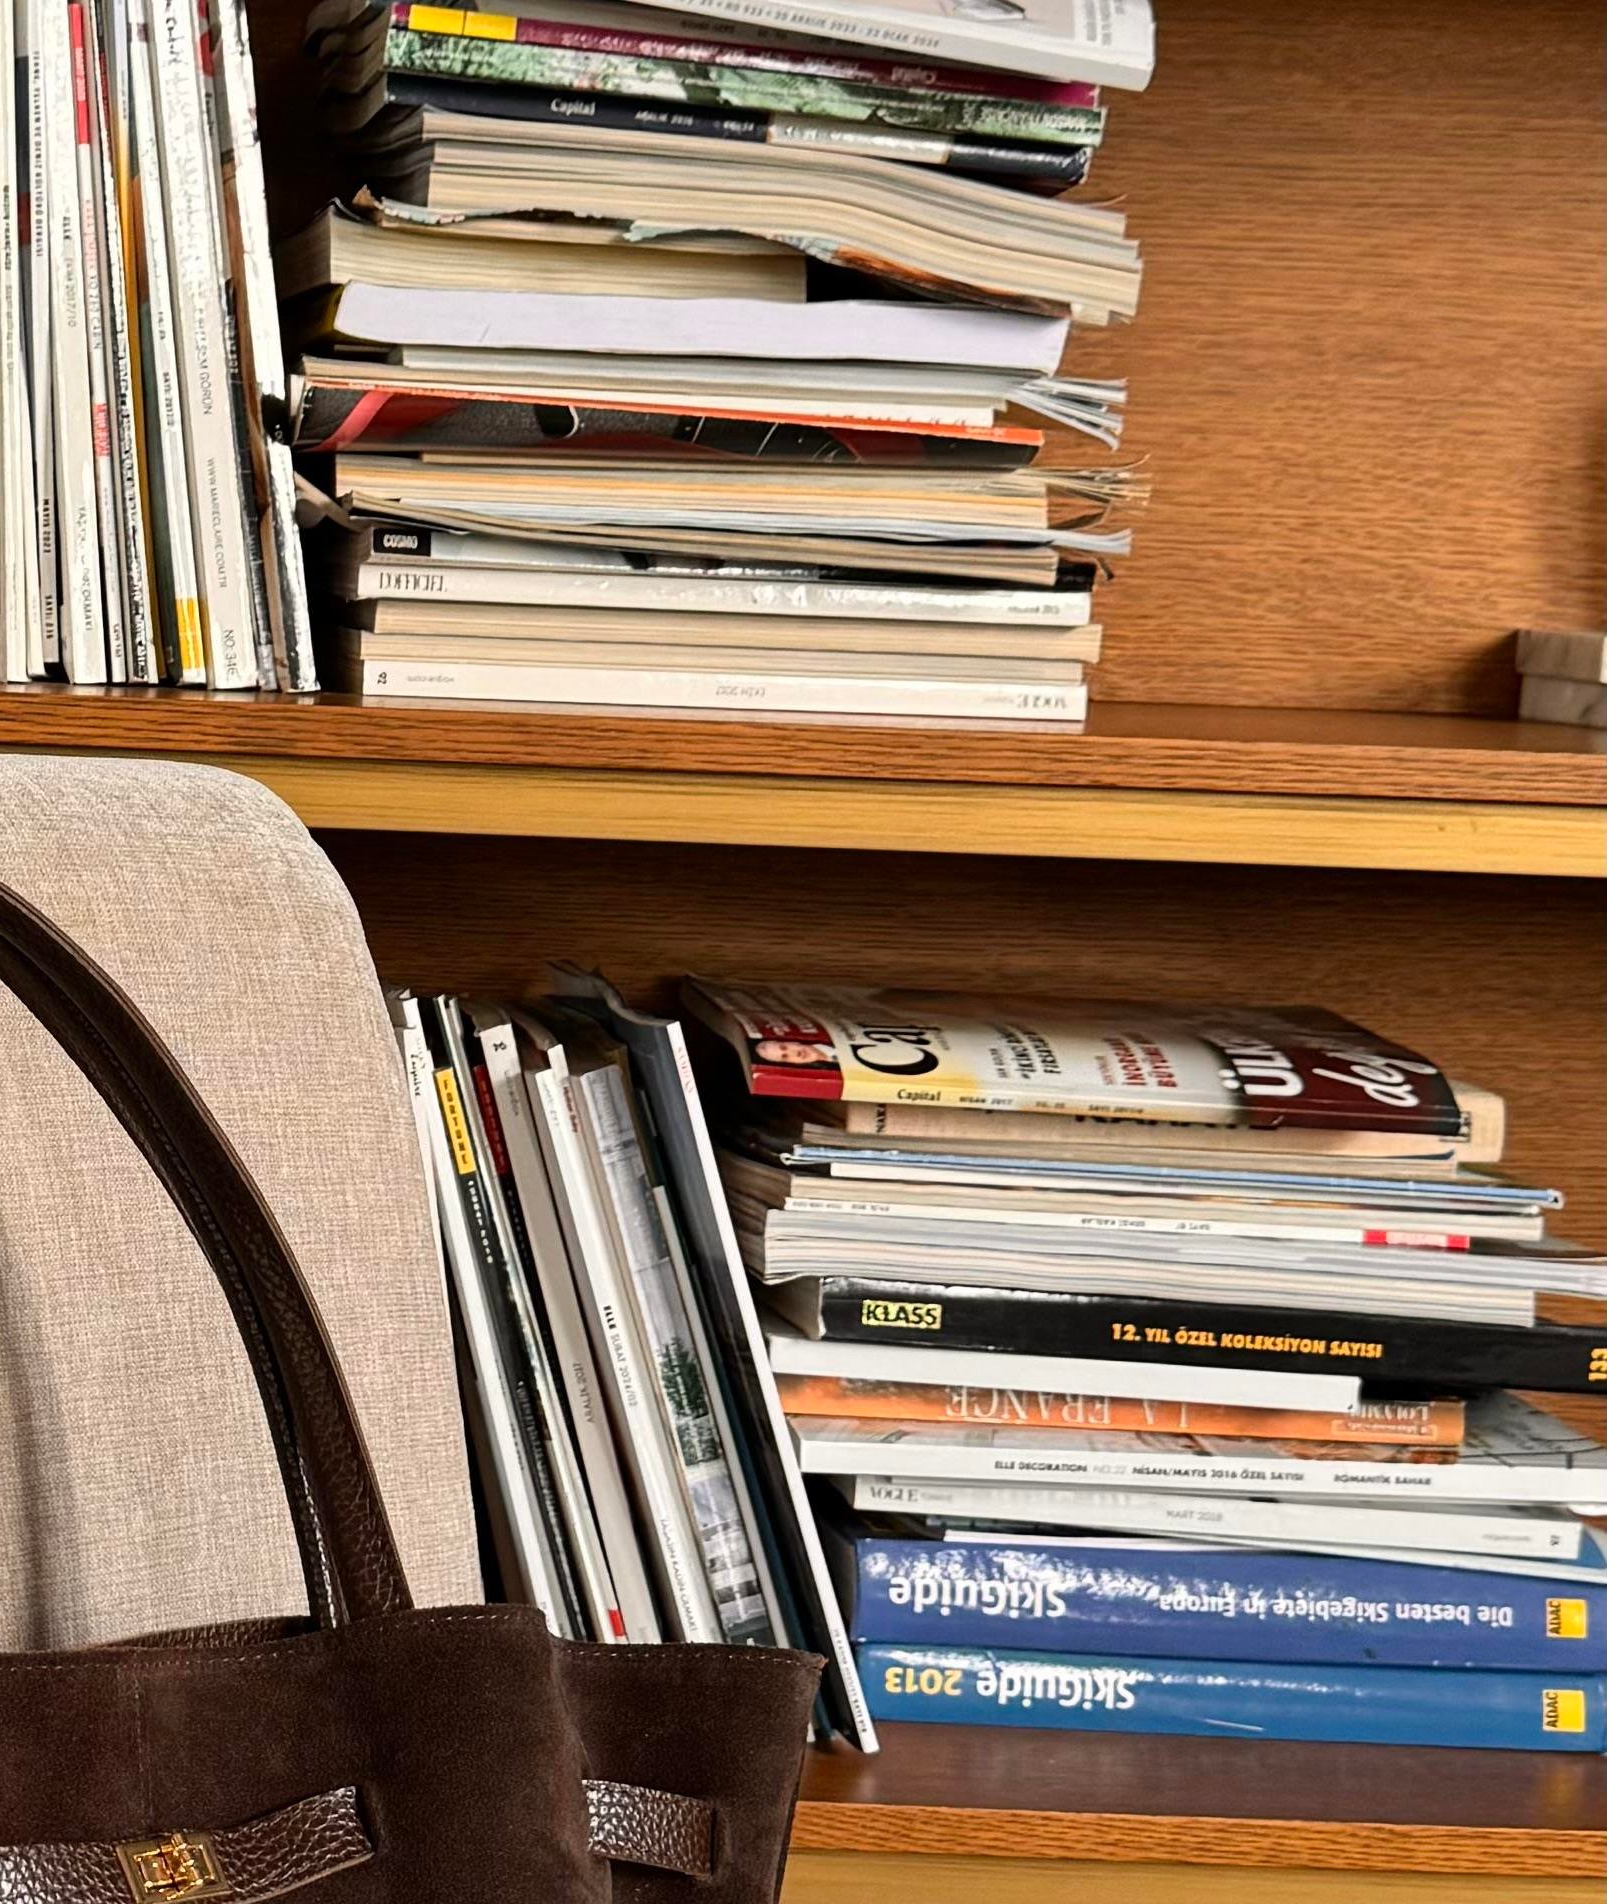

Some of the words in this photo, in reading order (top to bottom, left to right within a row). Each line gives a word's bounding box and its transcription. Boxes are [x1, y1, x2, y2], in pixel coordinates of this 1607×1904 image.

[550, 97, 597, 117] Capital
[62, 215, 73, 241] ELLE
[382, 533, 419, 550] COSMO
[896, 1088, 942, 1102] Capital
[442, 1079, 469, 1166] FORTUNE
[603, 1305, 618, 1330] ELLE
[867, 1303, 939, 1326] KLASS
[1111, 1322, 1142, 1342] 12.
[1144, 1326, 1172, 1345] YIL
[1174, 1325, 1219, 1348] ÖZEL
[1220, 1332, 1327, 1355] KOLEKSİYON
[1329, 1340, 1384, 1359] SAYISI
[945, 1385, 1112, 1426] FRANCE
[994, 1459, 1016, 1471] ELLE
[1018, 1460, 1089, 1473] DECORATION
[1132, 1464, 1208, 1479] NİSAN/MAYIS
[1210, 1468, 1238, 1480] 2016
[1239, 1468, 1267, 1481] ÖZEL
[869, 1486, 919, 1503] VOGUE
[888, 1576, 1068, 1619] SkiGuide
[1159, 1587, 1236, 1618] Europa
[1242, 1597, 1266, 1621] in
[1272, 1595, 1389, 1623] Skigebiete
[1395, 1602, 1471, 1626] besten
[1476, 1605, 1514, 1628] Die
[1547, 1599, 1563, 1636] ADAC
[884, 1666, 963, 1697] 2013
[976, 1667, 1136, 1710] SkiGuide
[1544, 1691, 1559, 1729] ADAC
